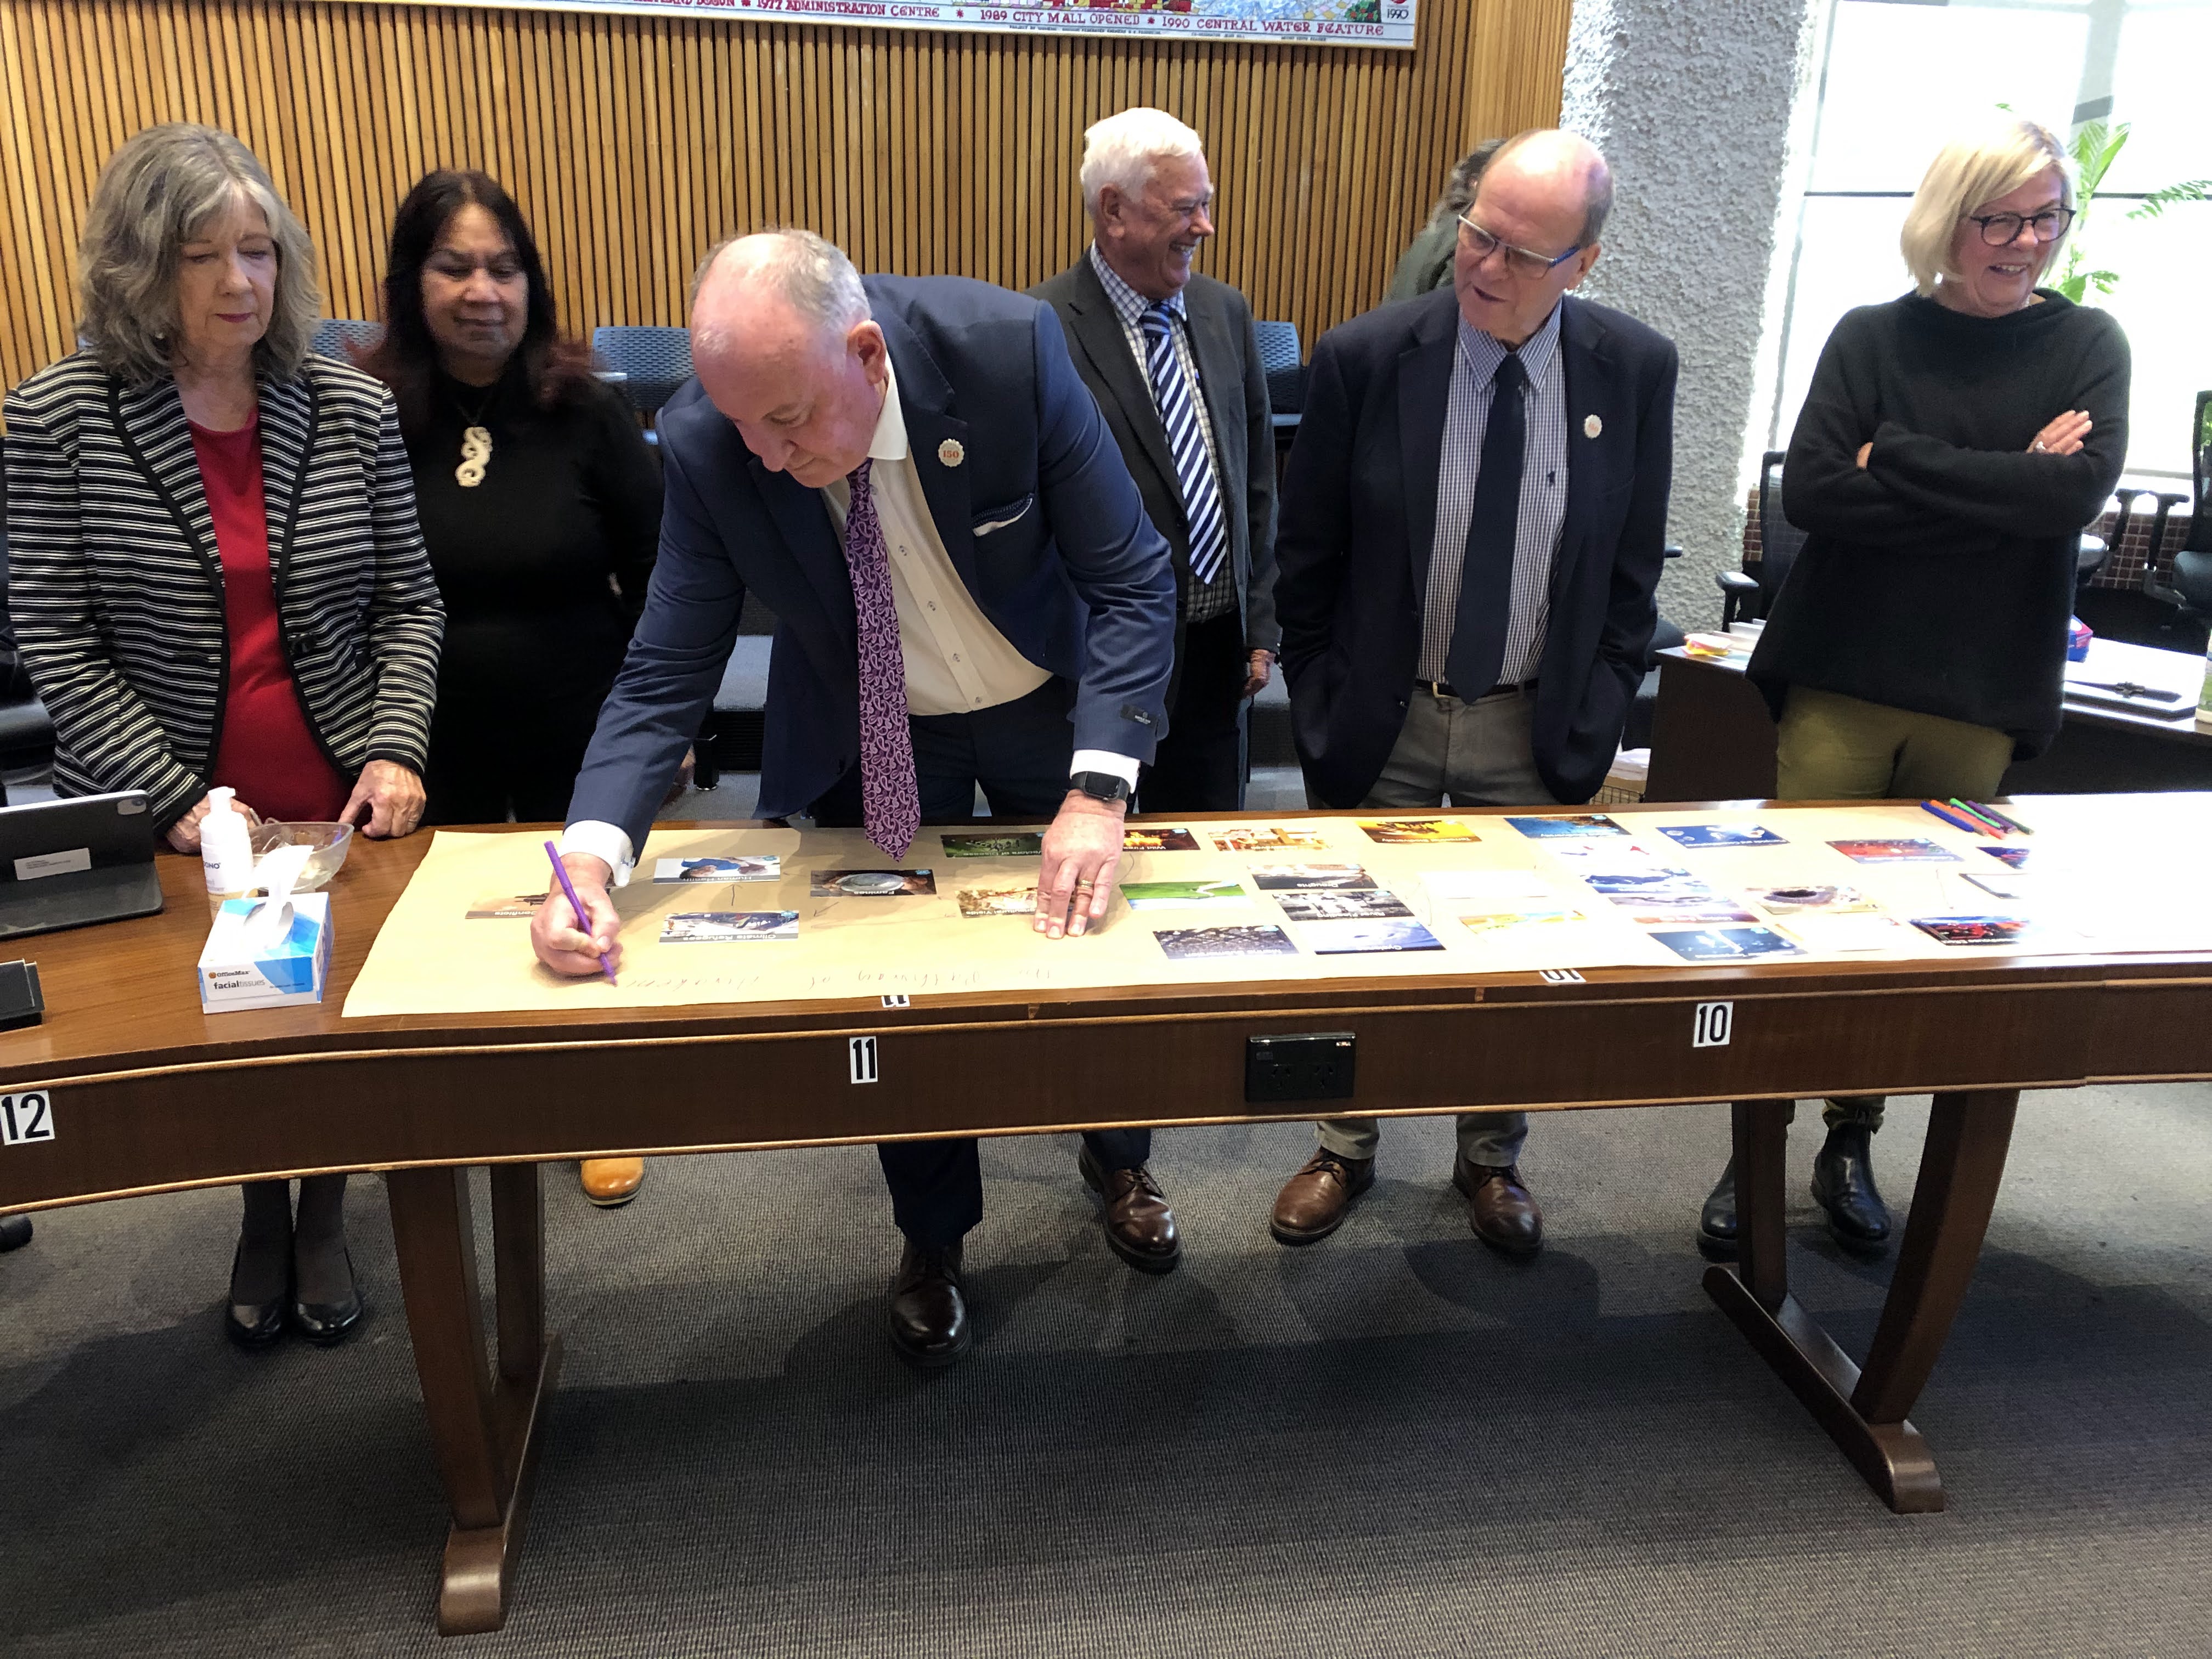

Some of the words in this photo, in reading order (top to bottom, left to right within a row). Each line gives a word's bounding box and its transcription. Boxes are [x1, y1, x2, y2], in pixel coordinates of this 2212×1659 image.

[757, 0, 783, 10] 1977
[785, 0, 887, 15] ADMINISTRATION
[890, 5, 940, 18] CENTRE
[981, 9, 1008, 21] 1989
[1013, 12, 1044, 24] CITY
[1047, 14, 1086, 24] MALL
[1089, 14, 1141, 25] OPENED
[1162, 16, 1190, 29] 1990
[1197, 19, 1258, 31] CENTRAL
[1261, 21, 1310, 33] WATER
[1317, 23, 1384, 36] FEATURE
[1387, 8, 1409, 20] 1990
[943, 450, 960, 458] 150
[1698, 1005, 1728, 1043] 10
[853, 1039, 876, 1080] 11
[1, 1093, 50, 1141] 12
